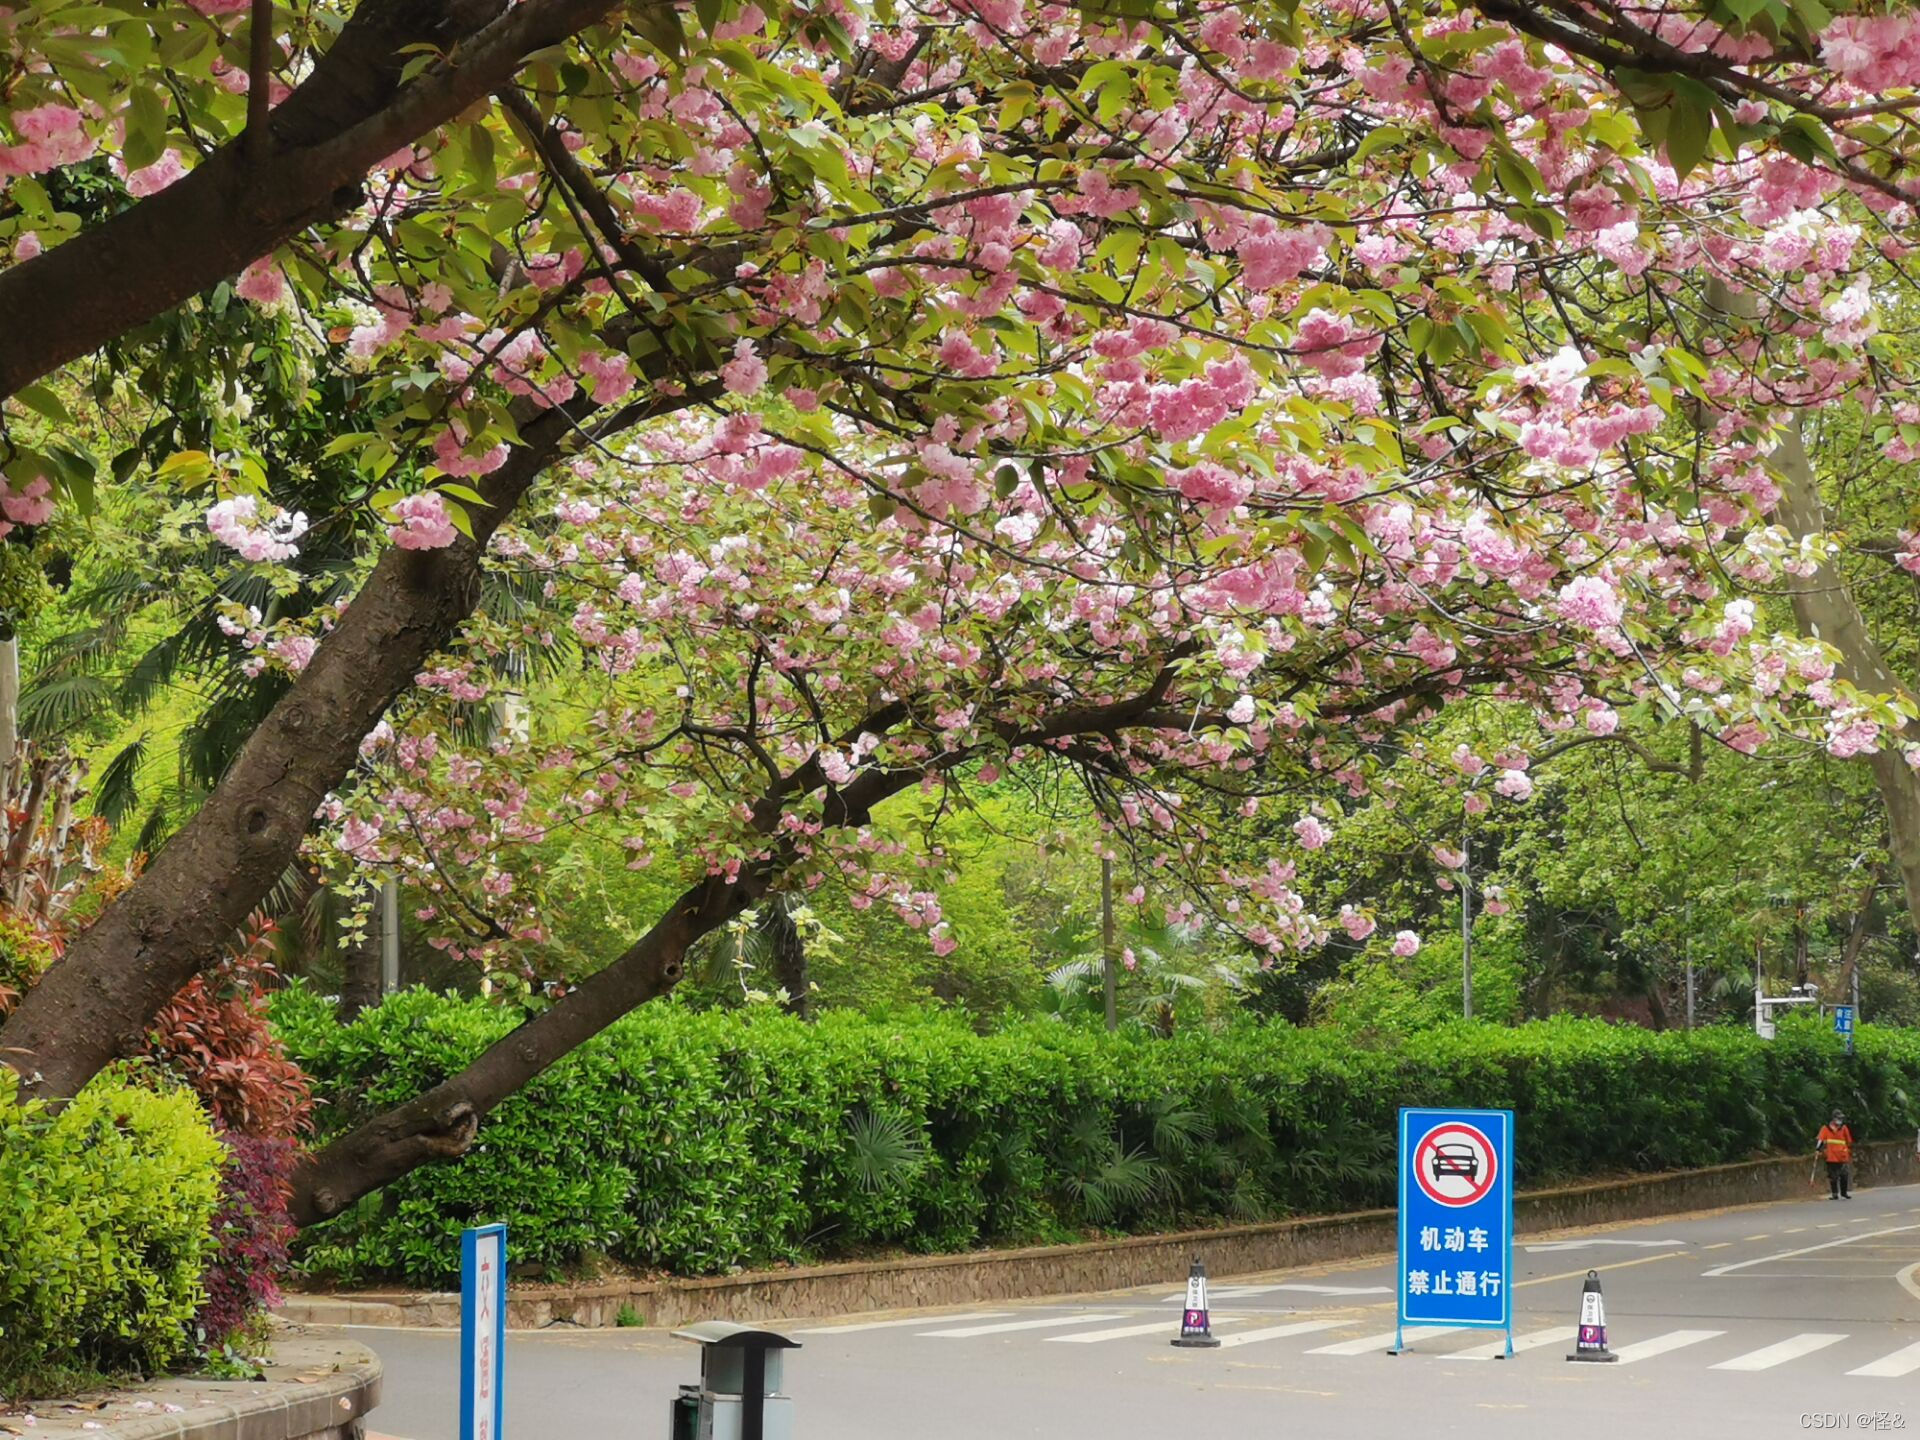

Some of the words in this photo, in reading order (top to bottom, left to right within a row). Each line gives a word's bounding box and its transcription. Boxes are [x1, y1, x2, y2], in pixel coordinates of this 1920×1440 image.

[1420, 1226, 1489, 1253] 机动车
[1408, 1270, 1501, 1297] 禁止通行
